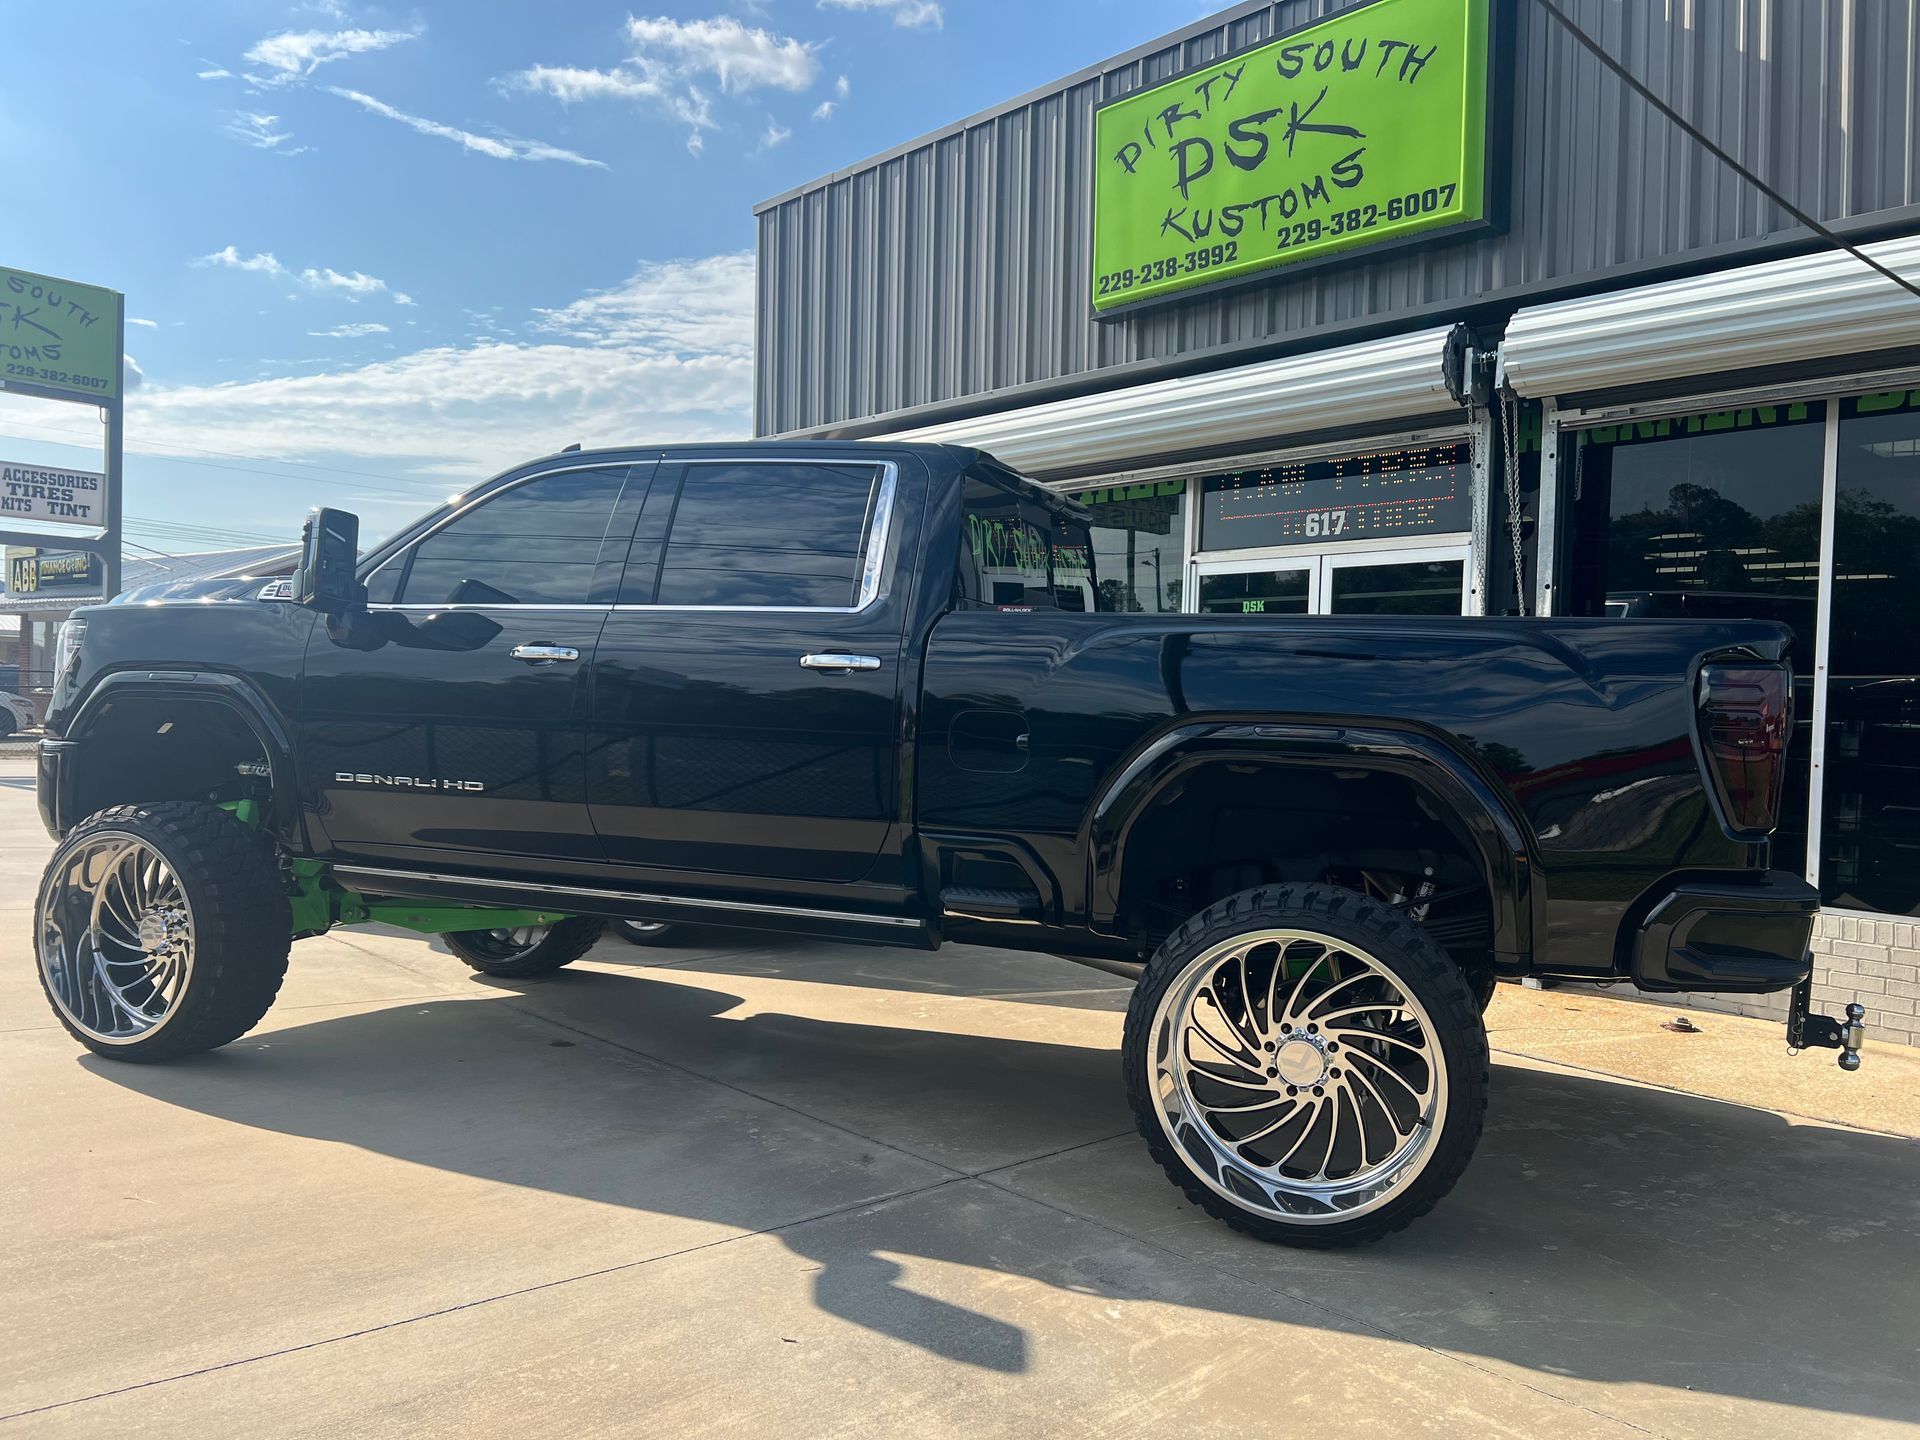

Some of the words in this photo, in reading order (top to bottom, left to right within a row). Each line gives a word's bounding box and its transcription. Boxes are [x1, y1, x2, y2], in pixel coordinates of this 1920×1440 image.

[1114, 63, 1245, 173] DIRTY
[1277, 38, 1437, 84] SOUTH
[1169, 86, 1366, 200] DSK
[1161, 147, 1366, 243] KUSTOMS
[1098, 241, 1238, 295] 229-238-3992
[1277, 183, 1457, 249] 229-382-6007
[7, 277, 99, 328] SOUTH
[6, 363, 108, 389] 229-382-6007
[2, 467, 98, 491] ACCESSORIES
[6, 482, 74, 502] TIRES
[1, 496, 32, 512] KITS
[47, 501, 91, 517] TINT
[1305, 510, 1346, 537] 617
[14, 560, 37, 592] ABB
[1242, 600, 1265, 615] DSK
[336, 772, 437, 789] DENALI
[443, 779, 484, 791] HD
